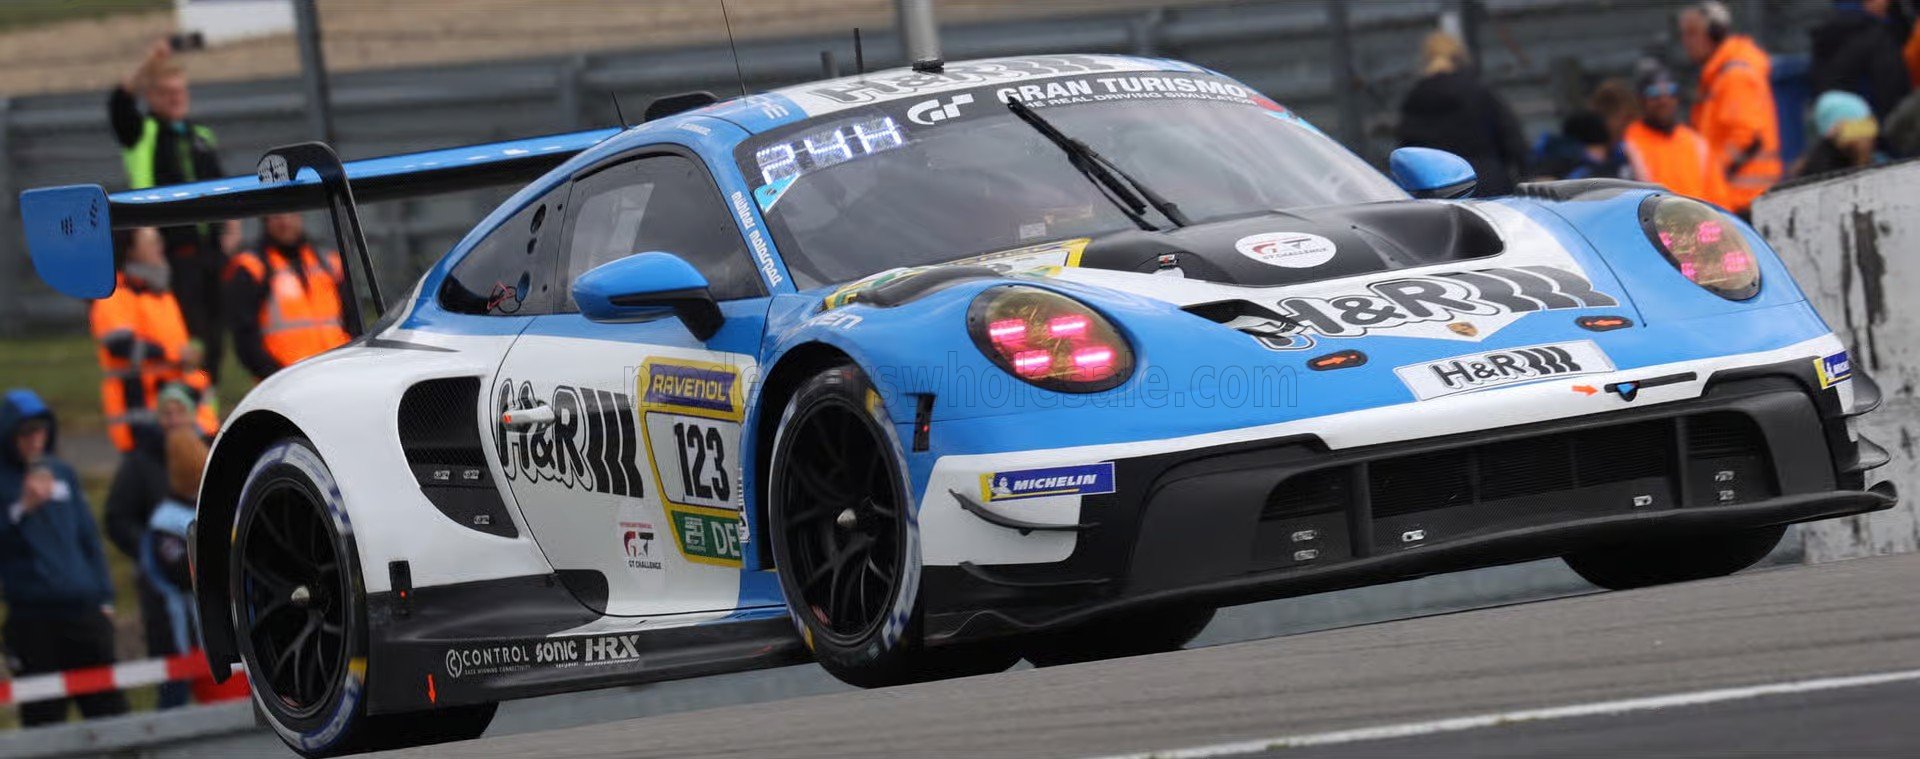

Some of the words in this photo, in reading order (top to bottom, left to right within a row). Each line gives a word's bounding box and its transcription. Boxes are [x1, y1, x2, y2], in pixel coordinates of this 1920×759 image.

[996, 79, 1093, 104] GRAN
[1097, 76, 1248, 98] TURISMO
[1047, 95, 1093, 106] REAL
[1094, 91, 1162, 101] DRIVING
[1164, 92, 1257, 105] SIMULATOR
[749, 230, 783, 287] motorsport
[1262, 279, 1490, 349] H&R
[652, 374, 727, 401] RAVENOL
[1430, 353, 1532, 391] H&R
[498, 380, 591, 487] H&R
[674, 422, 730, 501] 123
[1013, 474, 1098, 491] MICHELIN
[710, 521, 741, 558] DE
[635, 560, 662, 570] CHALLENGE
[462, 645, 530, 667] CONTROL
[585, 634, 640, 662] HRX
